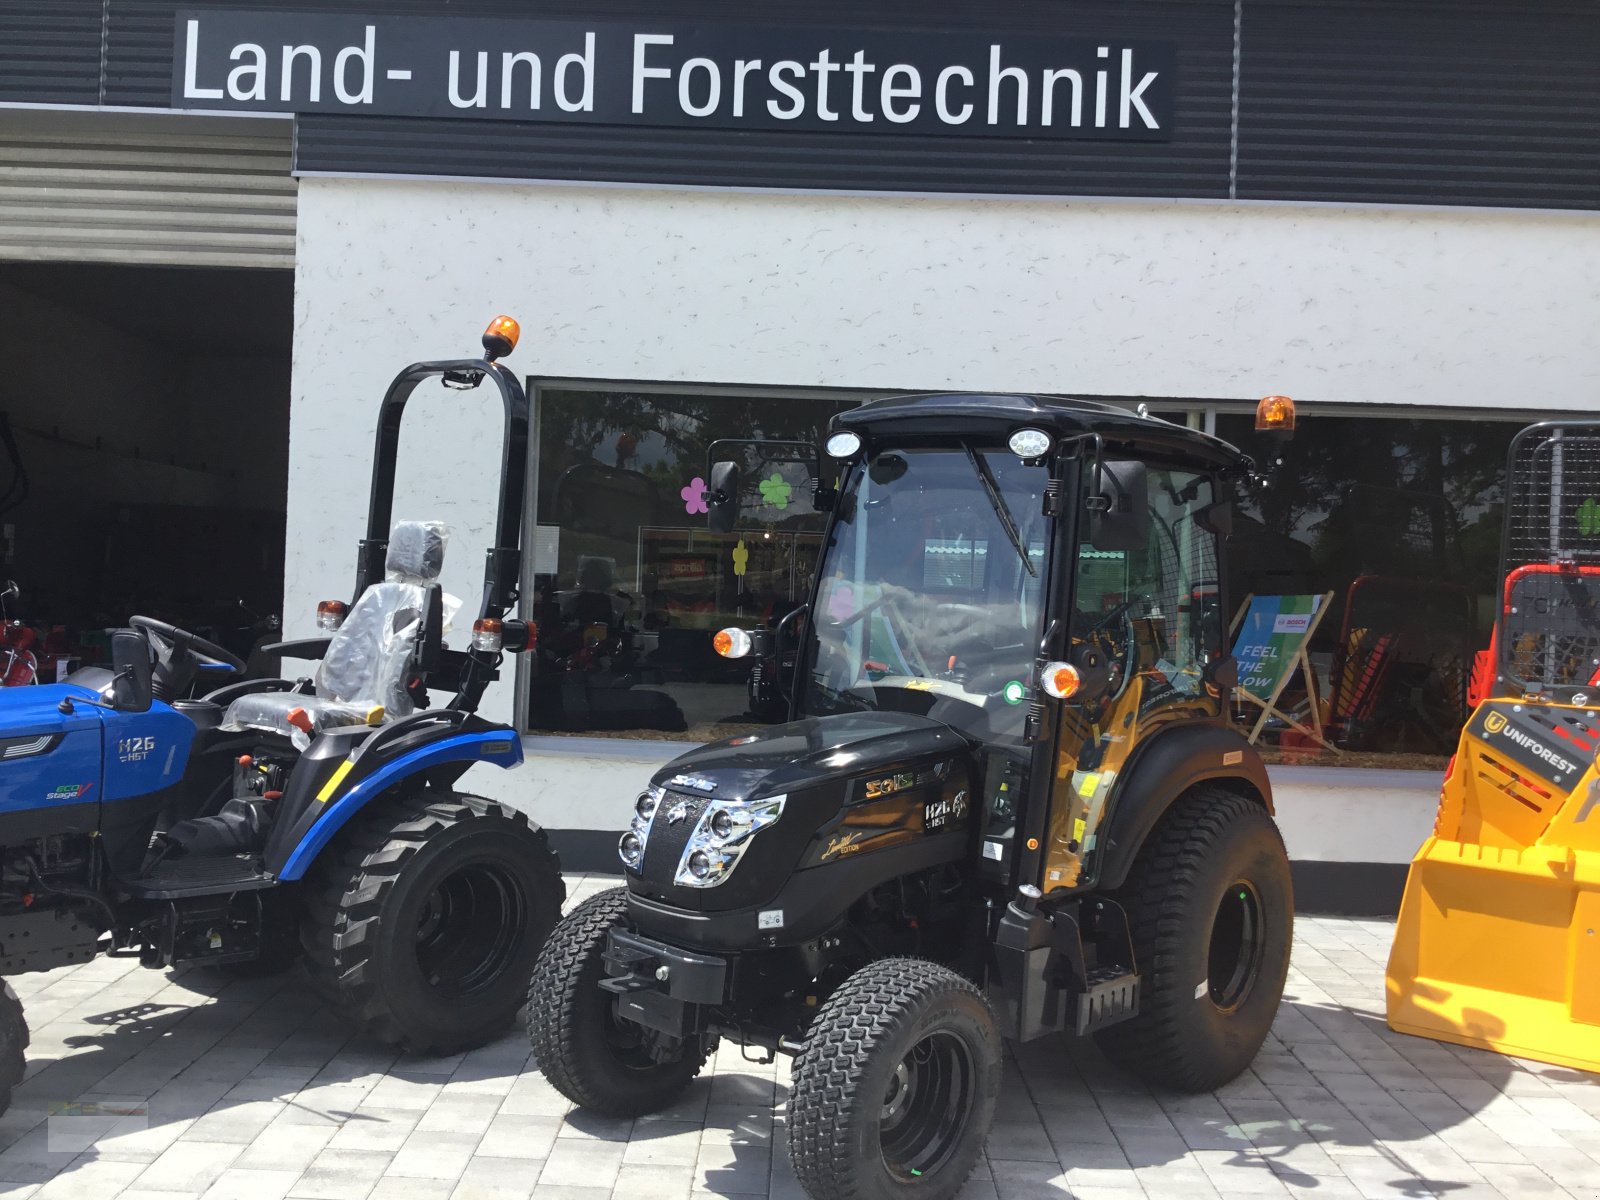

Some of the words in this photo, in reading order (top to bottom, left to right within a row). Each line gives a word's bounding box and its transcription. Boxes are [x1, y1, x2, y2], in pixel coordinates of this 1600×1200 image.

[183, 19, 412, 105] Land-
[447, 31, 596, 112] und
[631, 33, 1160, 129] Forsttechnik
[1236, 661, 1266, 673] THE
[1241, 645, 1278, 658] FEEL
[1503, 724, 1577, 775] UNIFOREST
